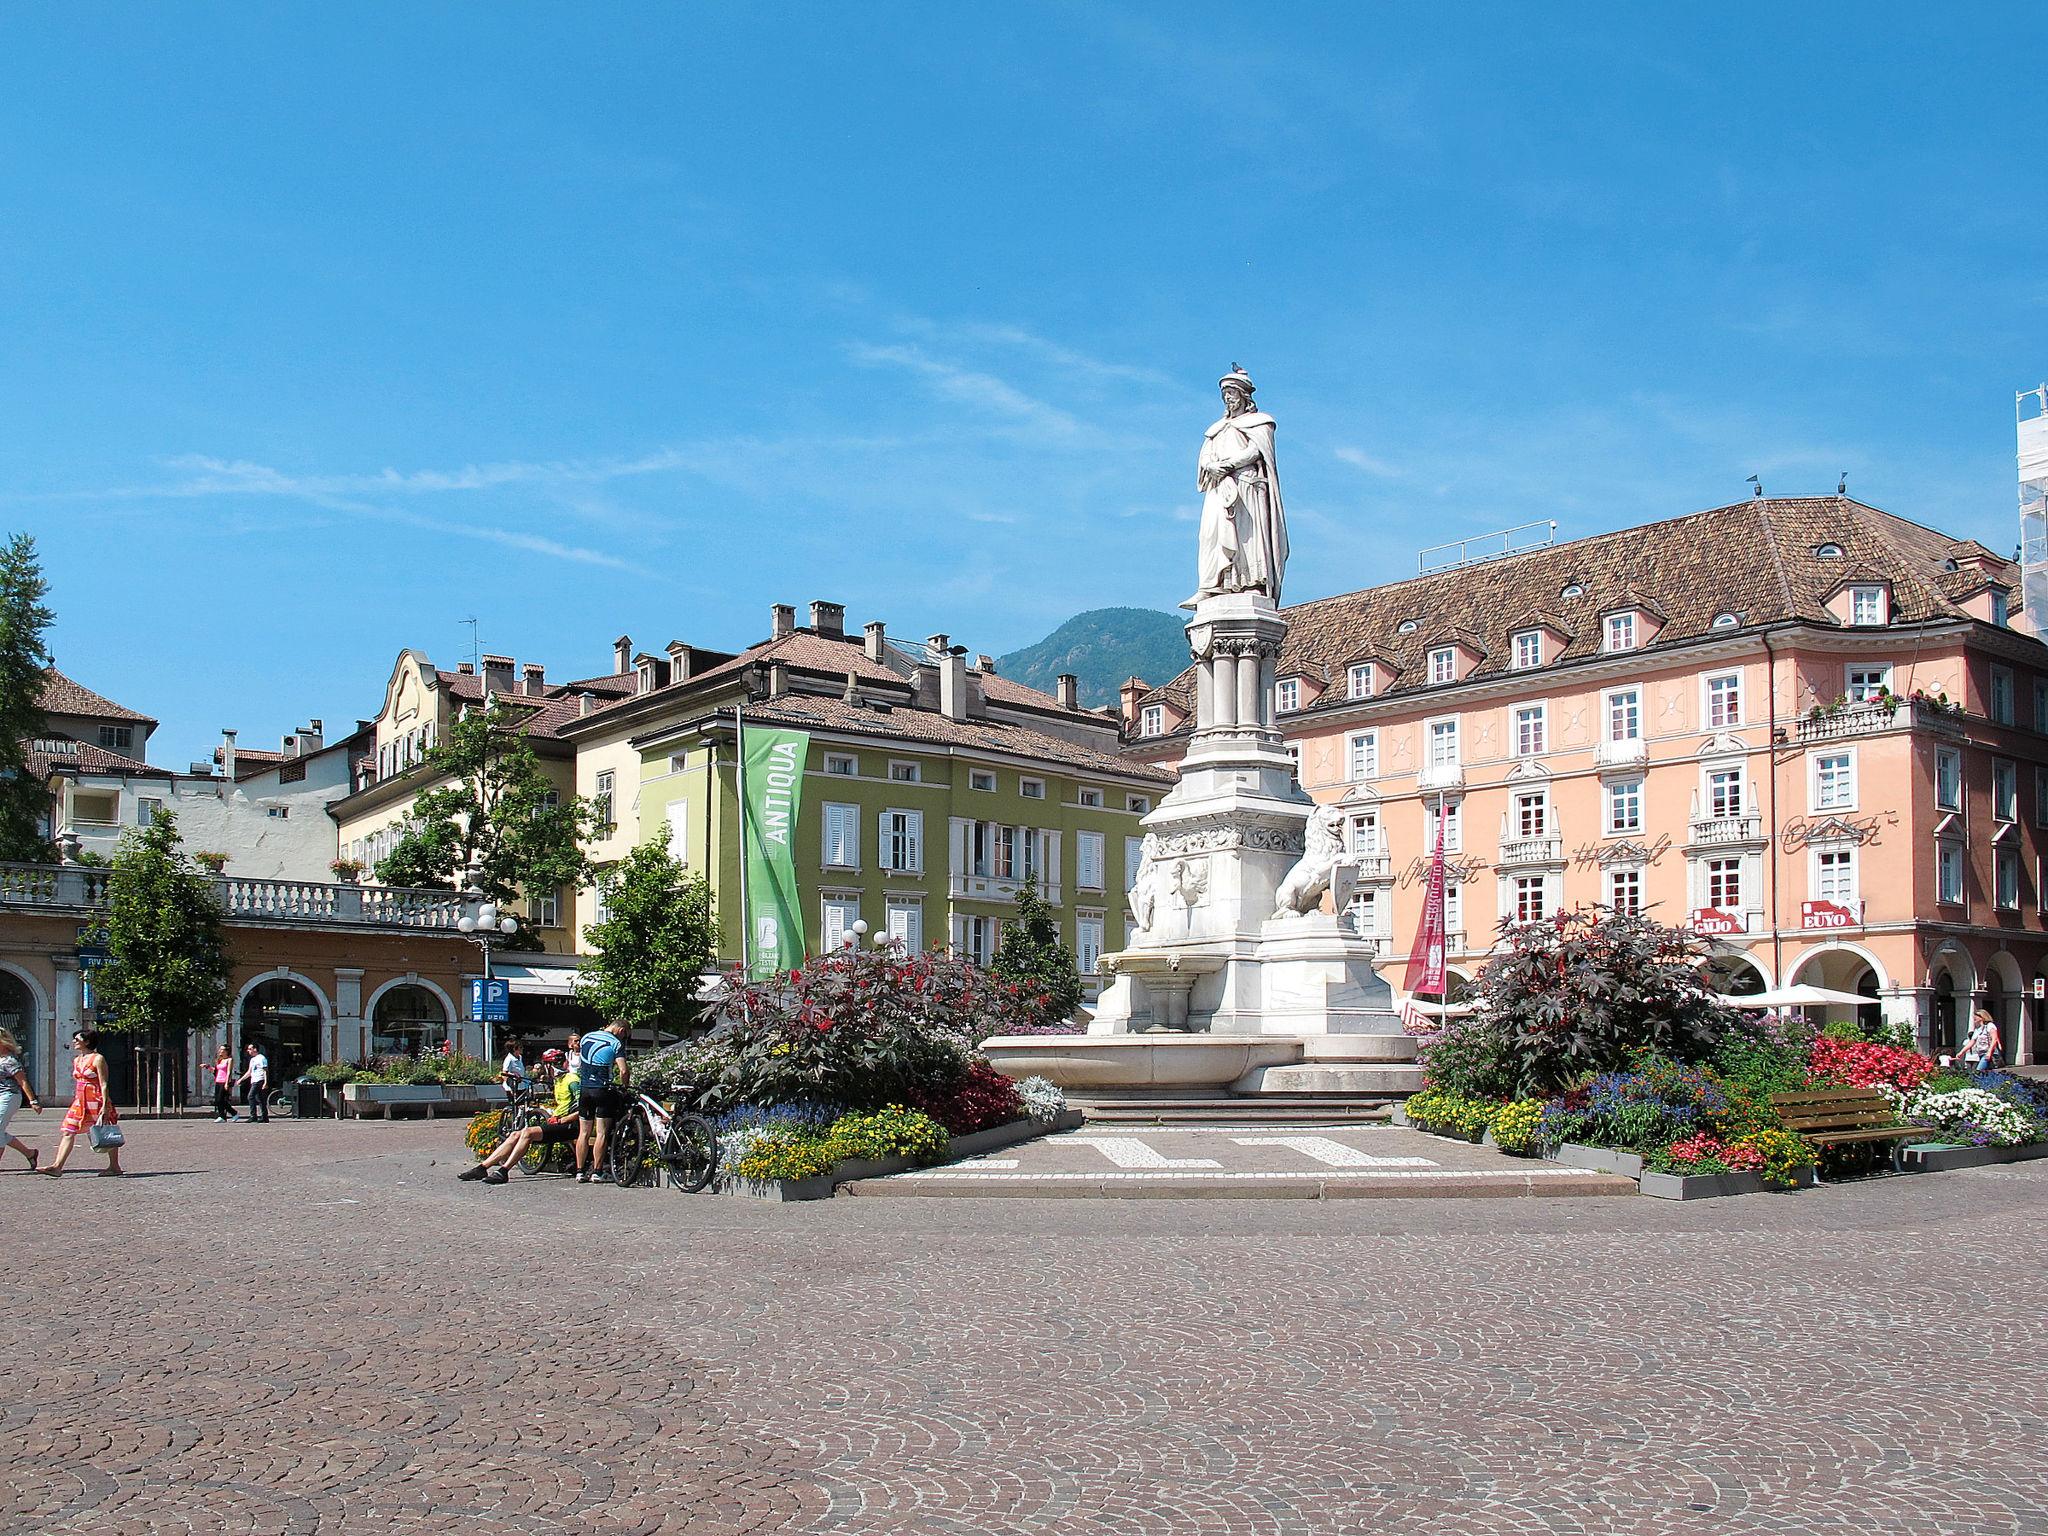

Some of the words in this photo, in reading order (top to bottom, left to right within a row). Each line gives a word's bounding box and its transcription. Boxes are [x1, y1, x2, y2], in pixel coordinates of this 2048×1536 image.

[765, 742, 799, 845] ANTIQUA
[1804, 914, 1846, 928] EUYO
[487, 986, 503, 1002] P
